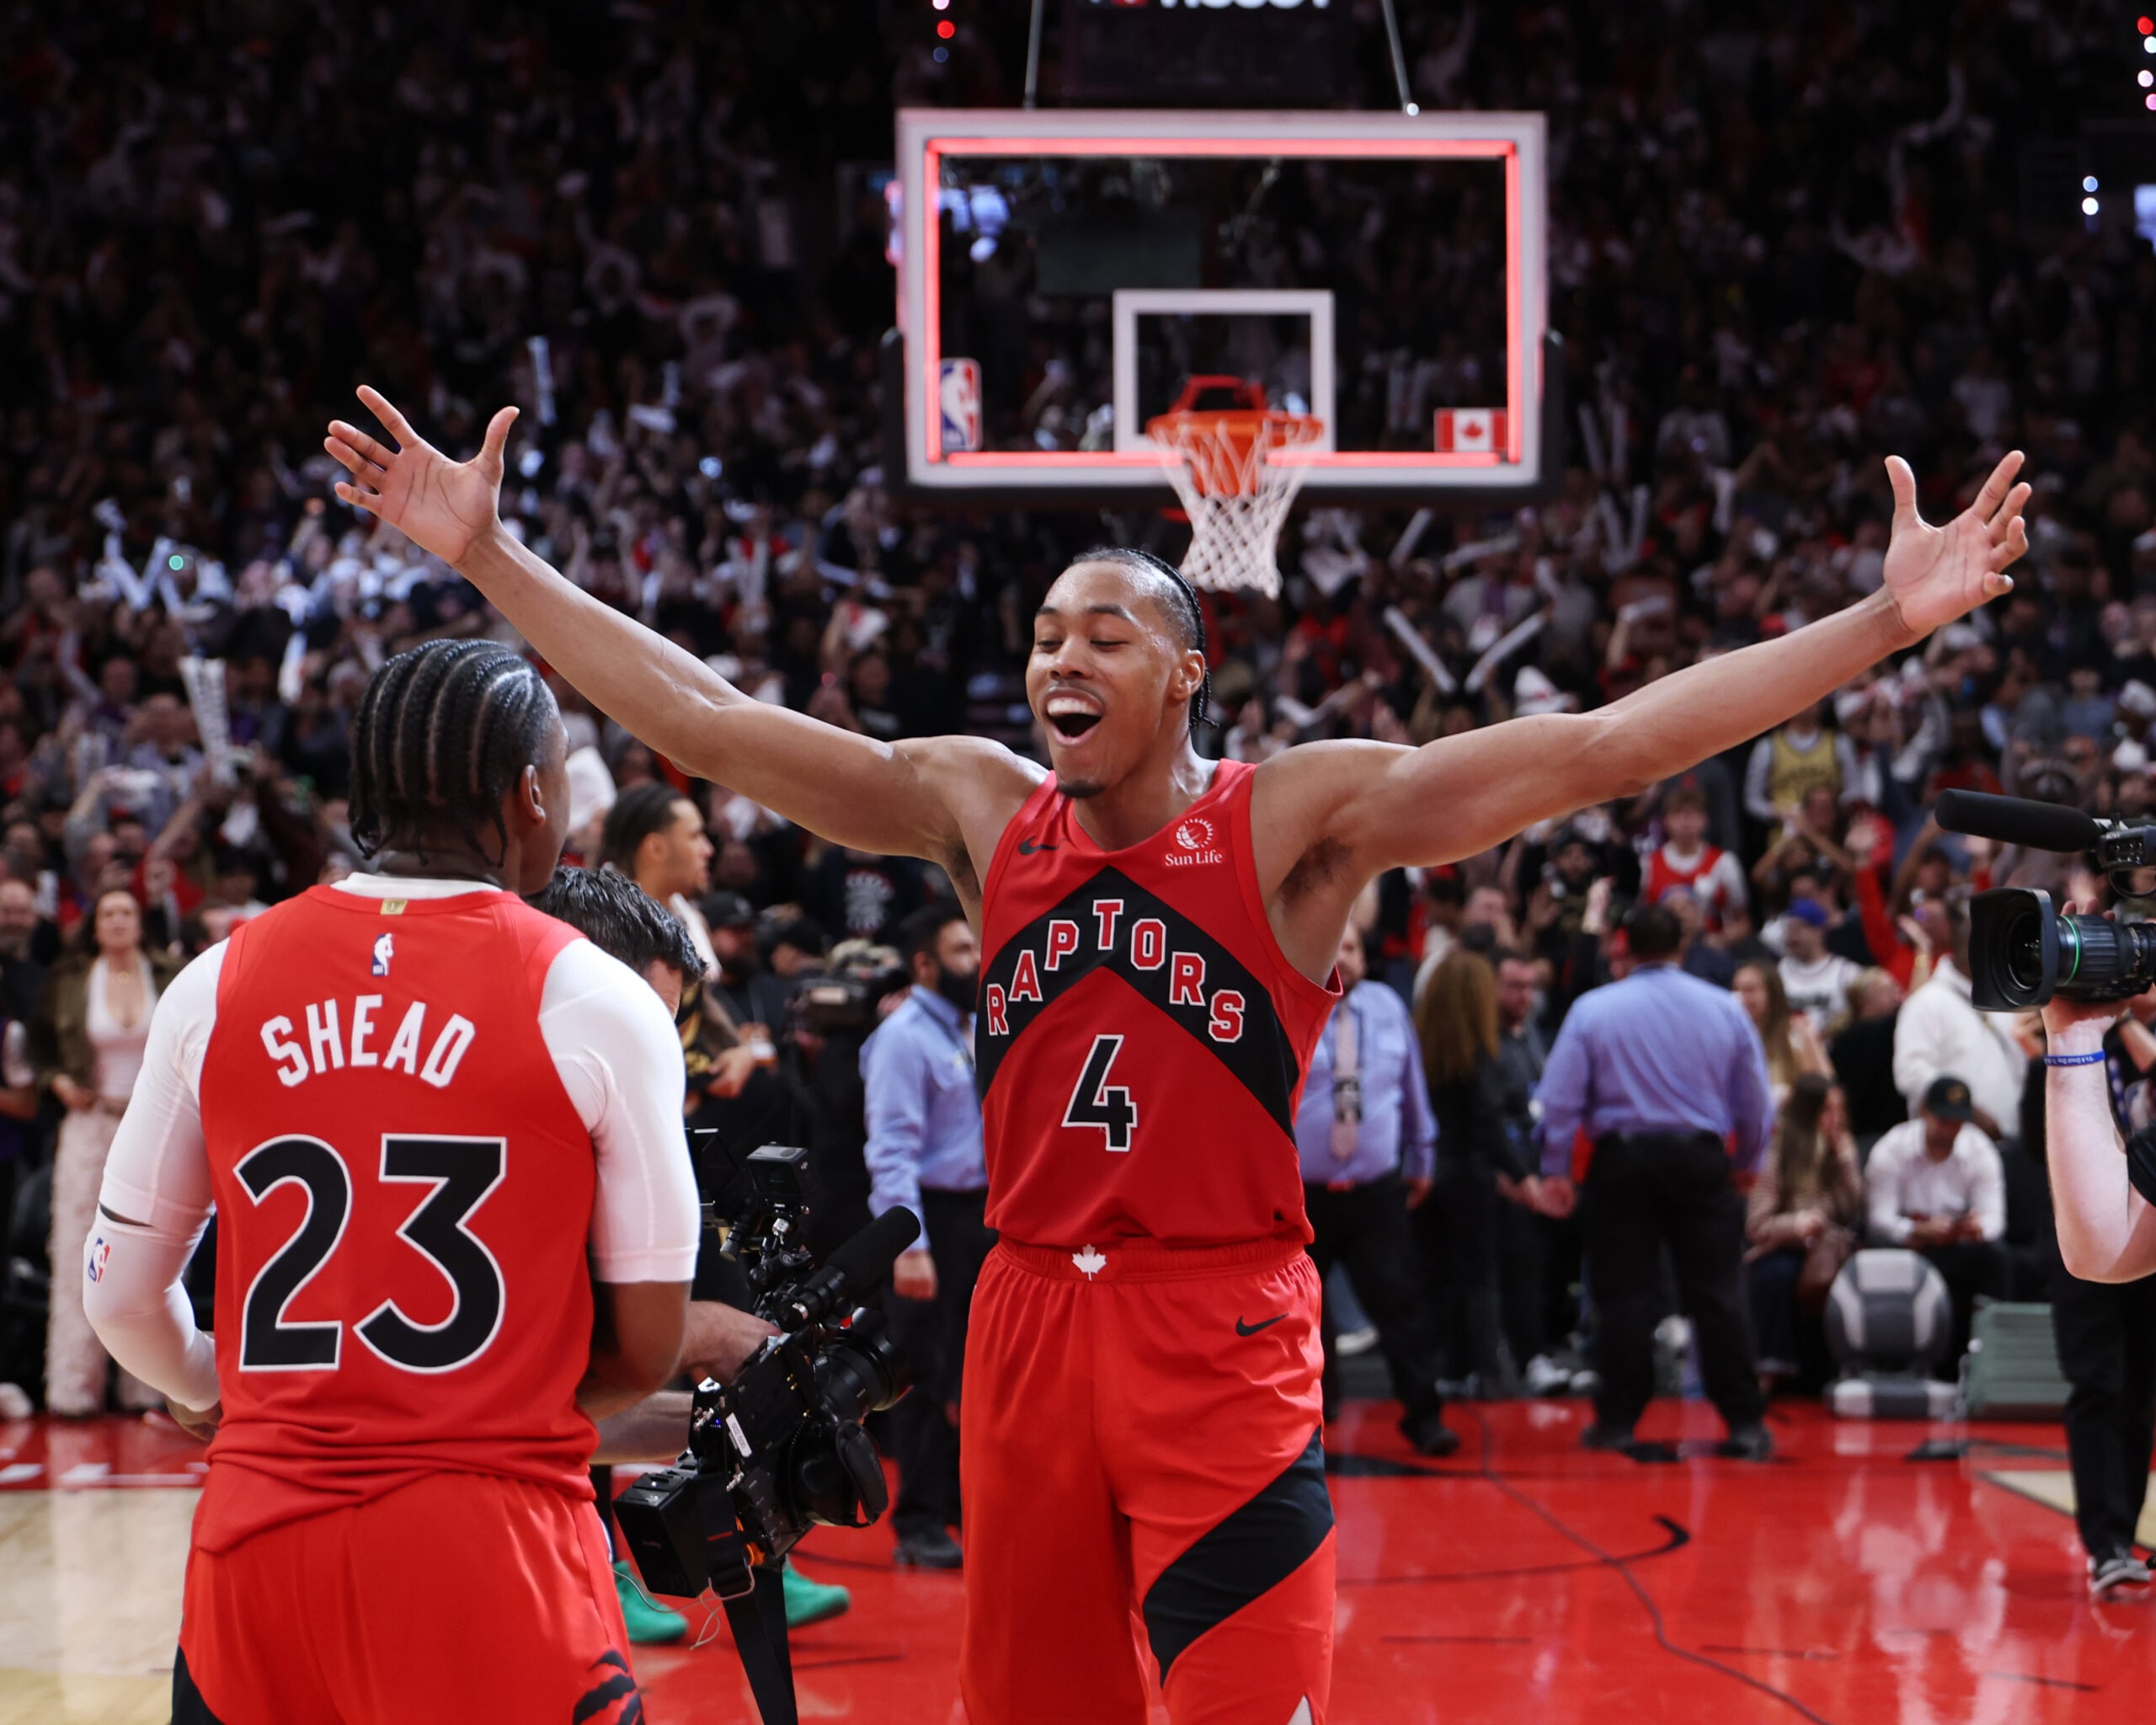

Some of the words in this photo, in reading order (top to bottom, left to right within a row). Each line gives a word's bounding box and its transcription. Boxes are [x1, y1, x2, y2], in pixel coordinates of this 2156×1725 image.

[1165, 852, 1193, 867] Sun
[1196, 849, 1223, 864] Life
[986, 899, 1246, 1044] RAPTORS
[260, 994, 476, 1088] SHEAD
[1061, 1033, 1138, 1152] 4
[232, 1133, 507, 1375] 23
